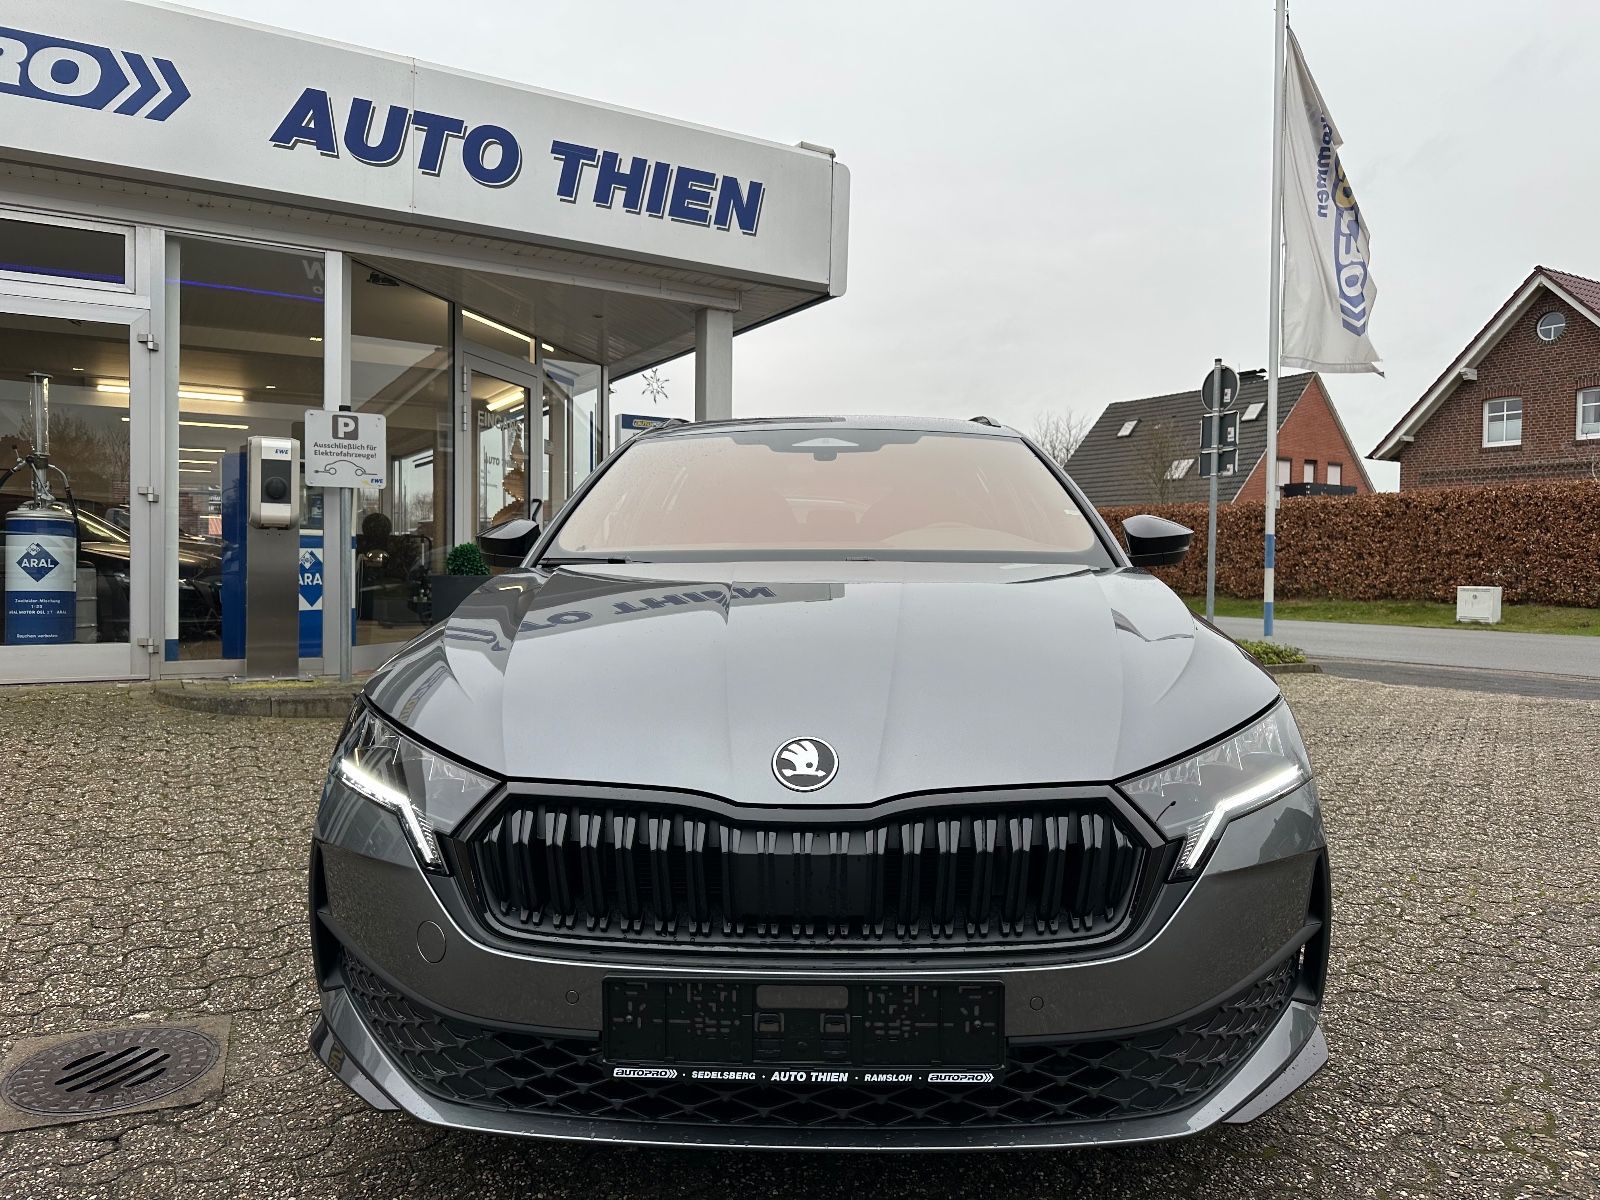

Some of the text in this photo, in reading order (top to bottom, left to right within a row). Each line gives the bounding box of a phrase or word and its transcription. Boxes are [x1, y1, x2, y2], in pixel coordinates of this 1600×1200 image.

[269, 87, 766, 237] AUTO THIEN
[337, 417, 356, 438] P
[313, 441, 365, 451] Ausschließlich
[313, 449, 377, 460] Elektrofahrzeuge!
[21, 558, 55, 568] ARAL
[691, 1070, 756, 1080] SEDELSBERG
[771, 1071, 806, 1082] AUTO
[810, 1072, 849, 1082] THIEN
[864, 1073, 913, 1082] RAMSLOH
